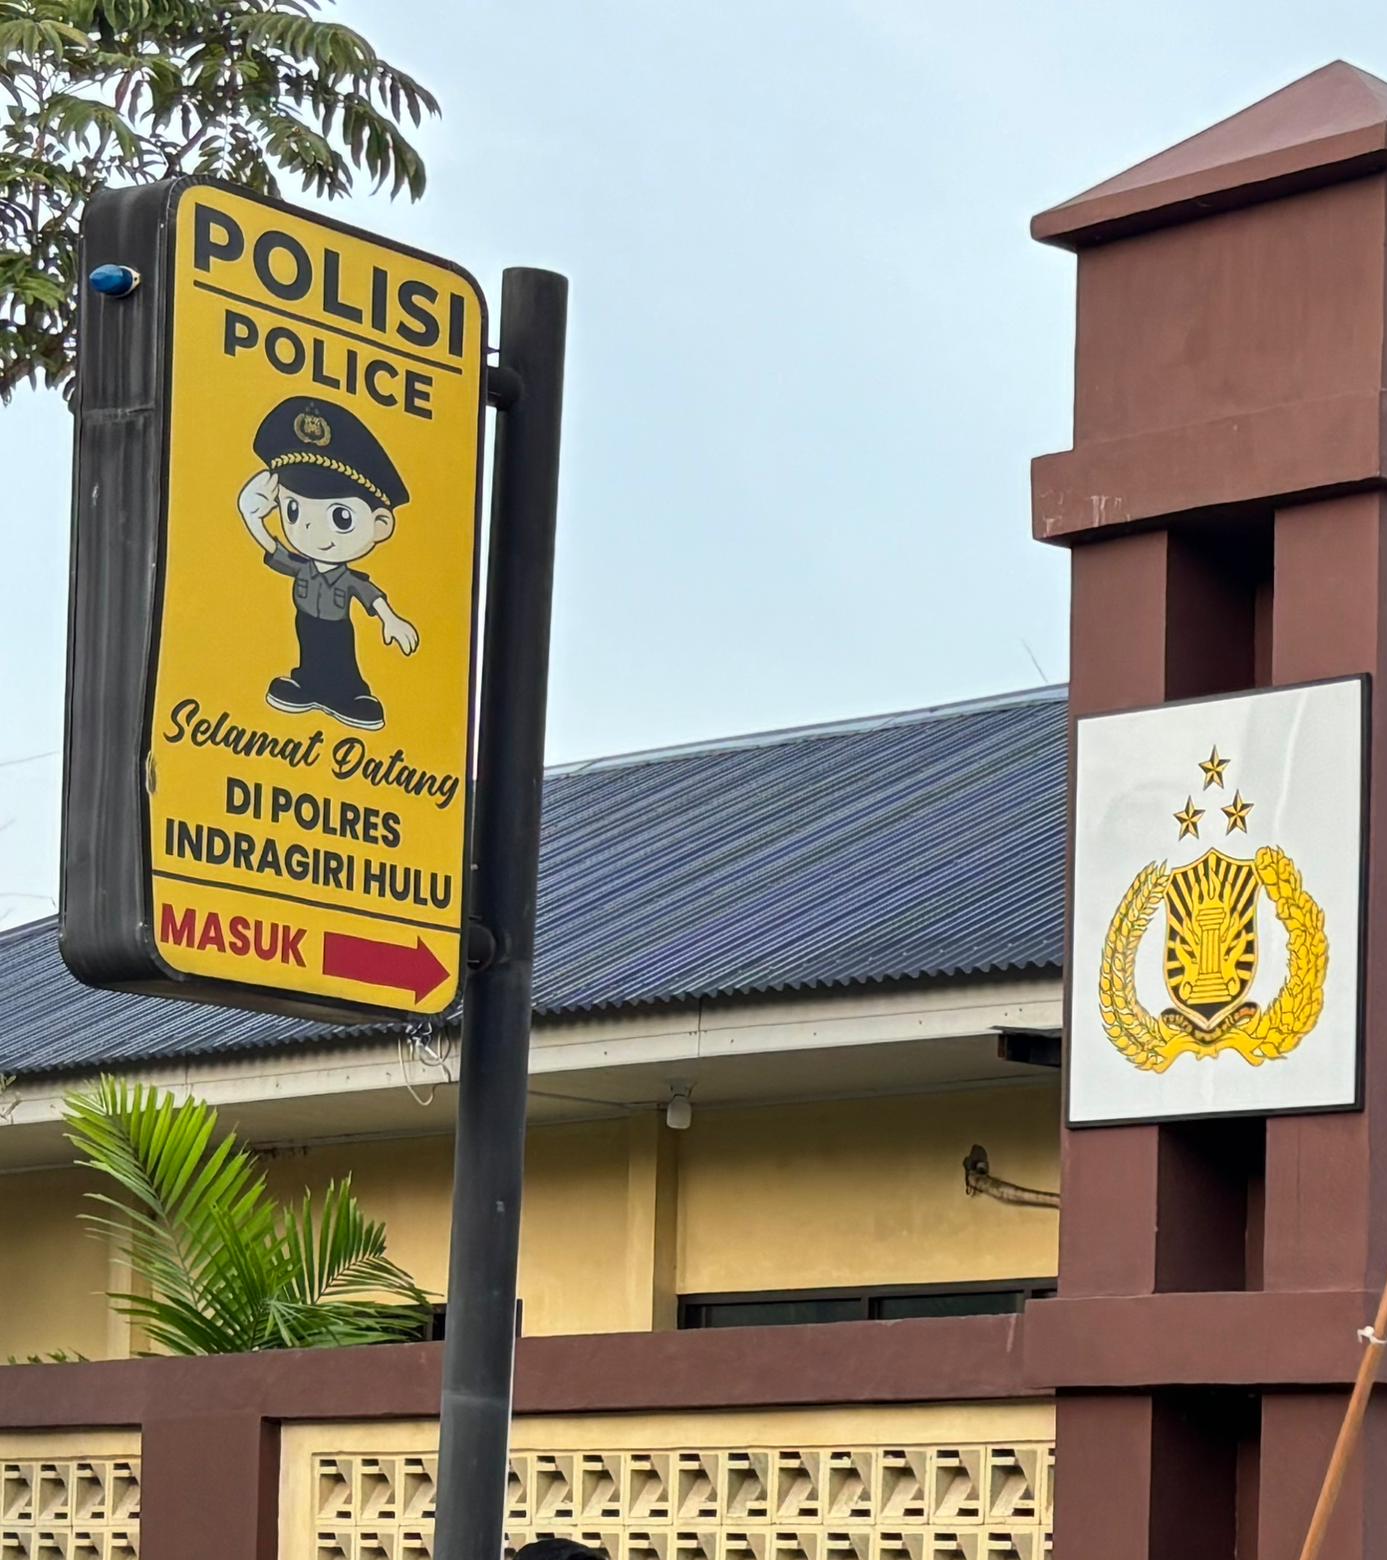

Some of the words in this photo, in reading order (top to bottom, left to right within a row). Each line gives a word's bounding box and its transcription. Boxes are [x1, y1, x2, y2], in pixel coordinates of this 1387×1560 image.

[193, 202, 465, 358] POLISI
[223, 308, 433, 420] POLICE
[163, 698, 324, 768] Selamat
[332, 737, 460, 810] Datang
[225, 776, 262, 820] DI
[271, 786, 401, 849] POLRES
[165, 818, 354, 892] INDRAGIRI
[363, 859, 452, 910] HULU
[160, 903, 308, 968] MASUK
